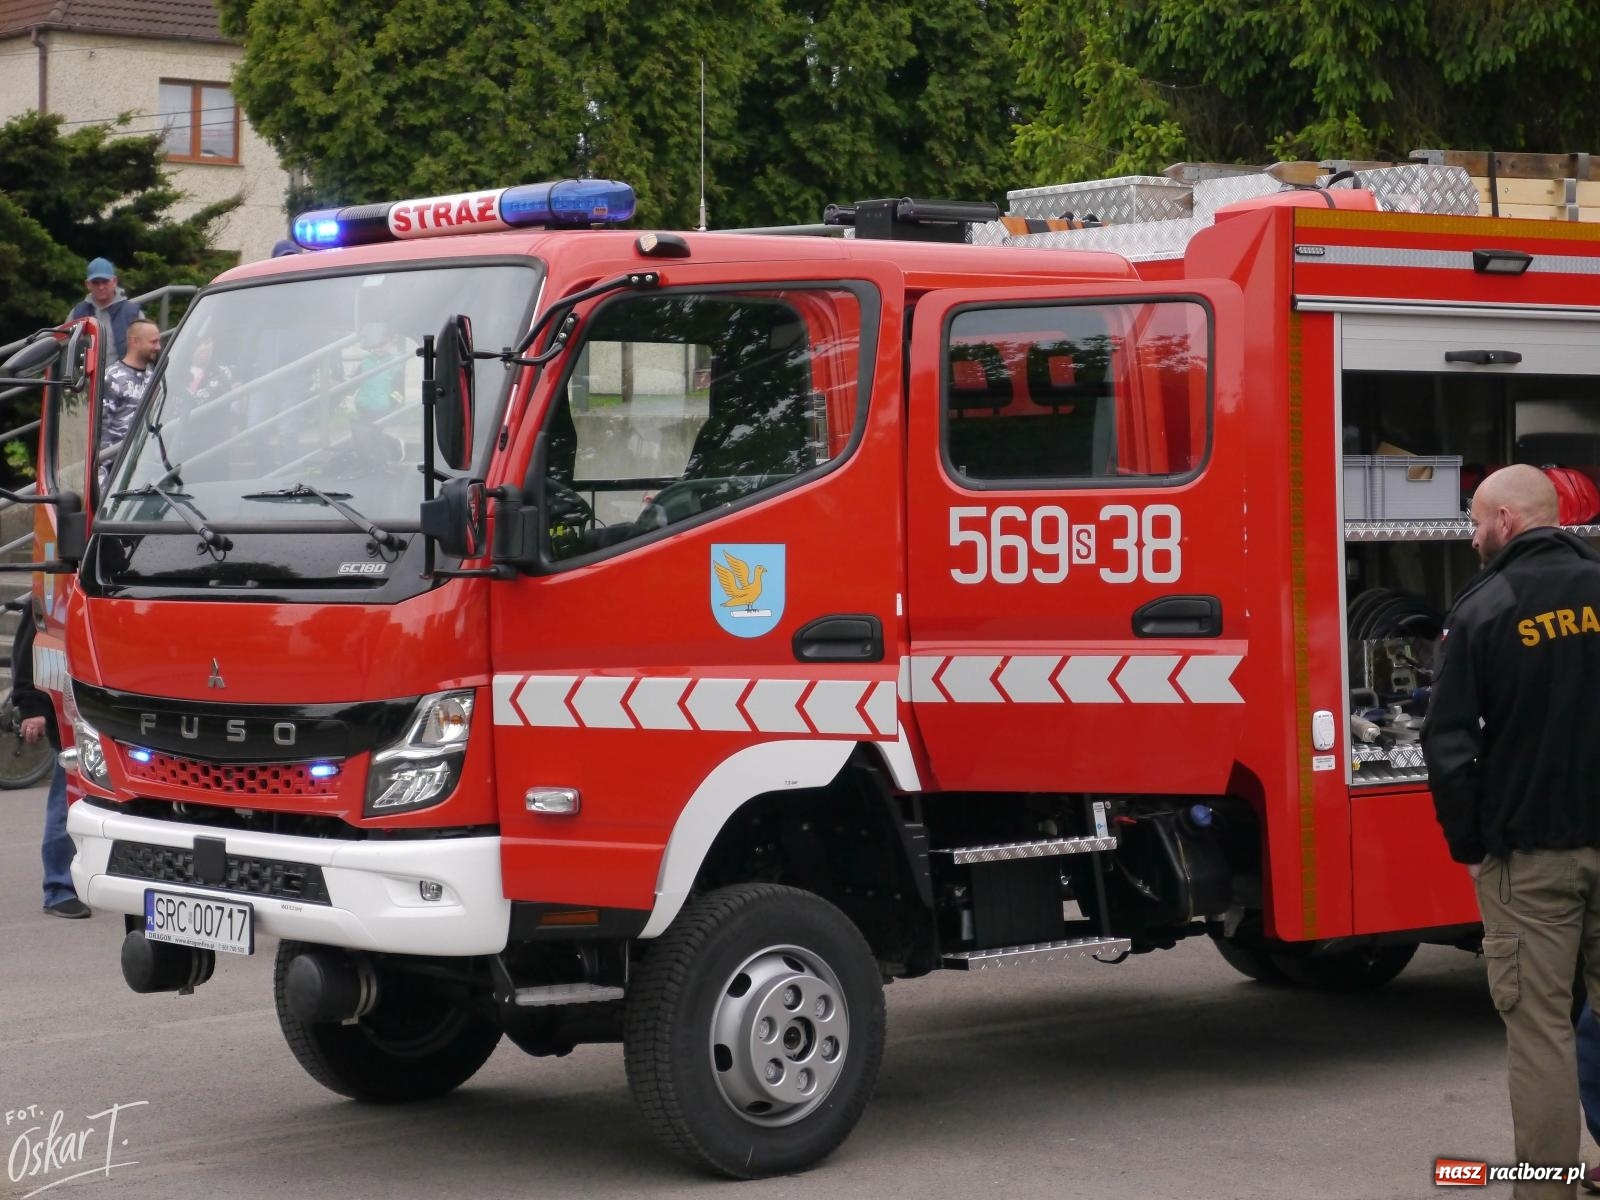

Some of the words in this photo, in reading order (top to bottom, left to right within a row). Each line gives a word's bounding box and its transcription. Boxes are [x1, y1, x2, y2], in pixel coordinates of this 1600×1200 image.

[140, 713, 297, 746] FUSO
[155, 897, 187, 933] SRC
[193, 902, 248, 942] 00717
